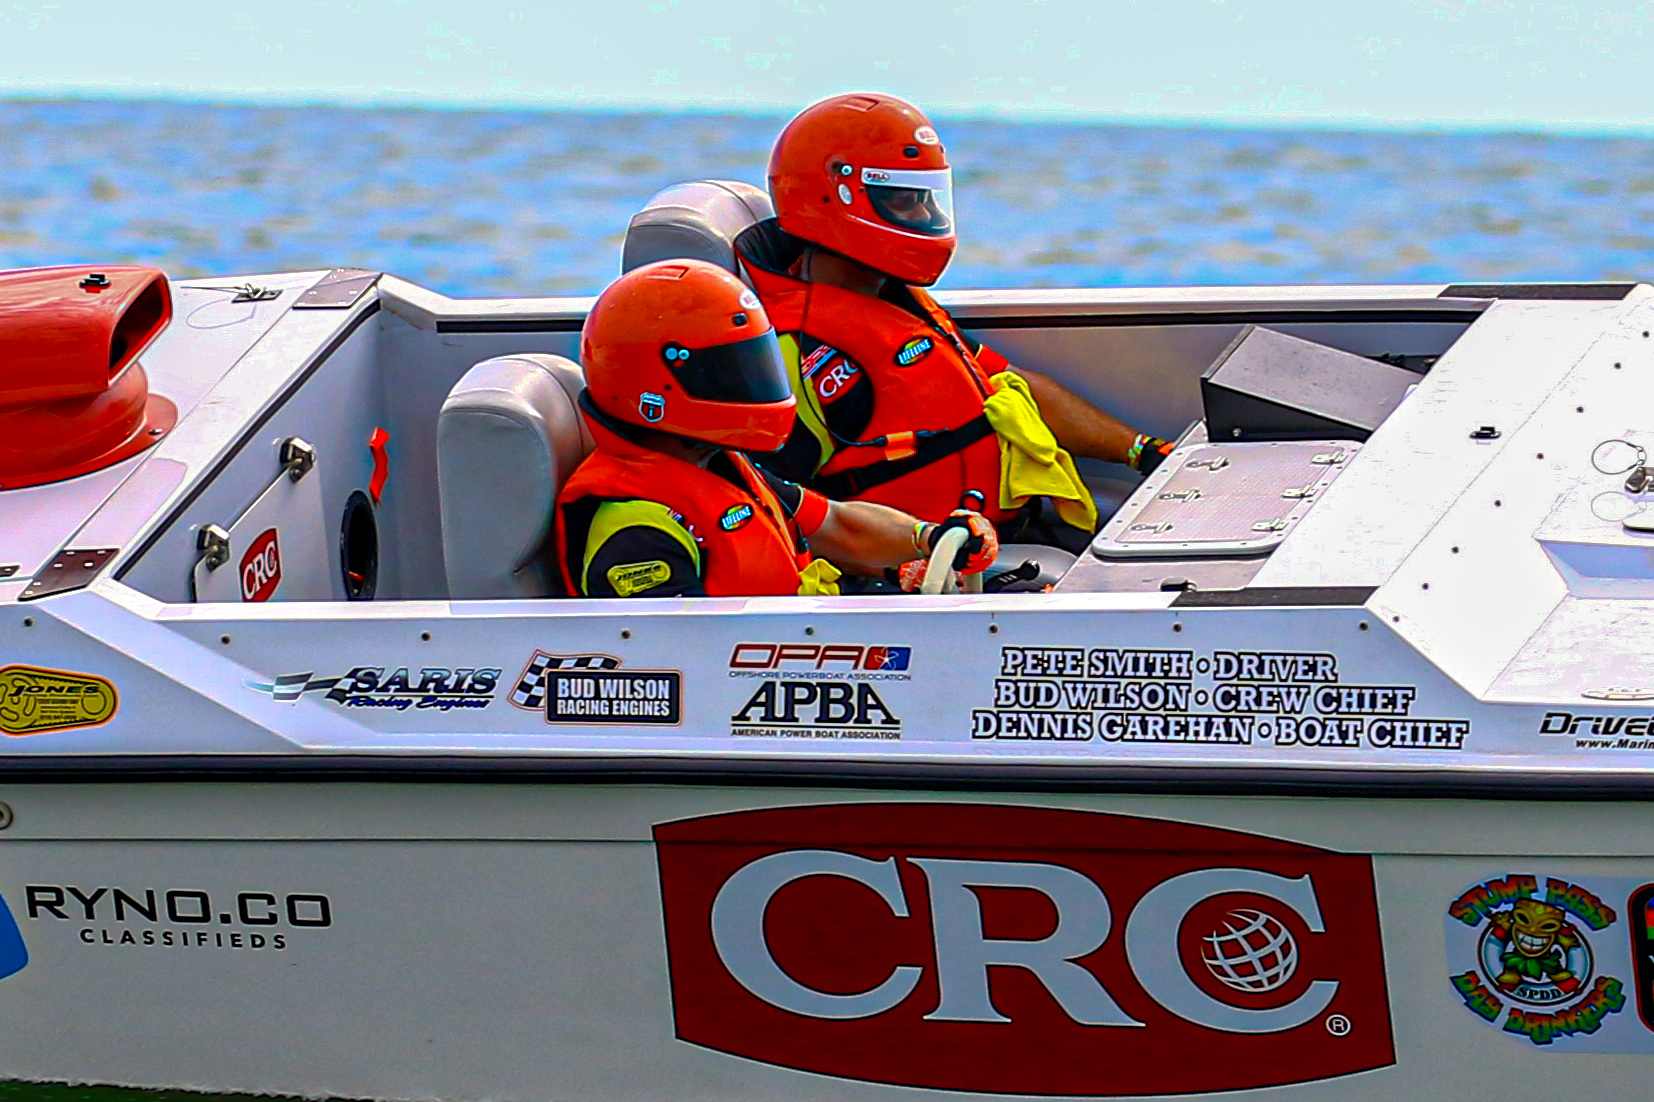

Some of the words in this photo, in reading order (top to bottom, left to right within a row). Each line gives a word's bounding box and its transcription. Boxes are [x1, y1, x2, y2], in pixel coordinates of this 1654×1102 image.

[243, 540, 278, 600] CRC
[729, 643, 865, 670] OPA
[1001, 647, 1084, 677] PETE
[1088, 648, 1193, 679] SMITH
[1213, 651, 1338, 682] DRIVER
[353, 667, 502, 693] SARIS
[557, 678, 595, 698] BUD
[600, 679, 670, 699] WILSON
[729, 670, 780, 679] OFFSHORE
[784, 671, 844, 680] POWERBOAT
[847, 672, 911, 681] ASSOCIATION
[8, 685, 99, 697] JONES
[731, 681, 901, 725] APBA
[995, 679, 1061, 708] BUD
[1063, 681, 1191, 711] WILSON
[1213, 684, 1310, 713] CREW
[1314, 685, 1416, 715] CHIEF
[557, 699, 609, 715] RACING
[612, 700, 670, 717] ENGINES
[731, 728, 777, 737] AMERICAN
[780, 729, 812, 738] POWER
[815, 730, 840, 739] BOAT
[841, 731, 901, 740] ASSOCIATION
[972, 710, 1093, 741] DENNIS
[1099, 713, 1254, 745] GAREHAN
[1275, 717, 1363, 747] BOAT
[1367, 718, 1470, 749] CHIEF
[25, 885, 332, 928] RYNO.CO
[1448, 874, 1539, 927] STUMP
[80, 929, 286, 949] CLASSIFIEDS
[711, 849, 1340, 1034] CRC
[1518, 987, 1561, 1000] SPDD
